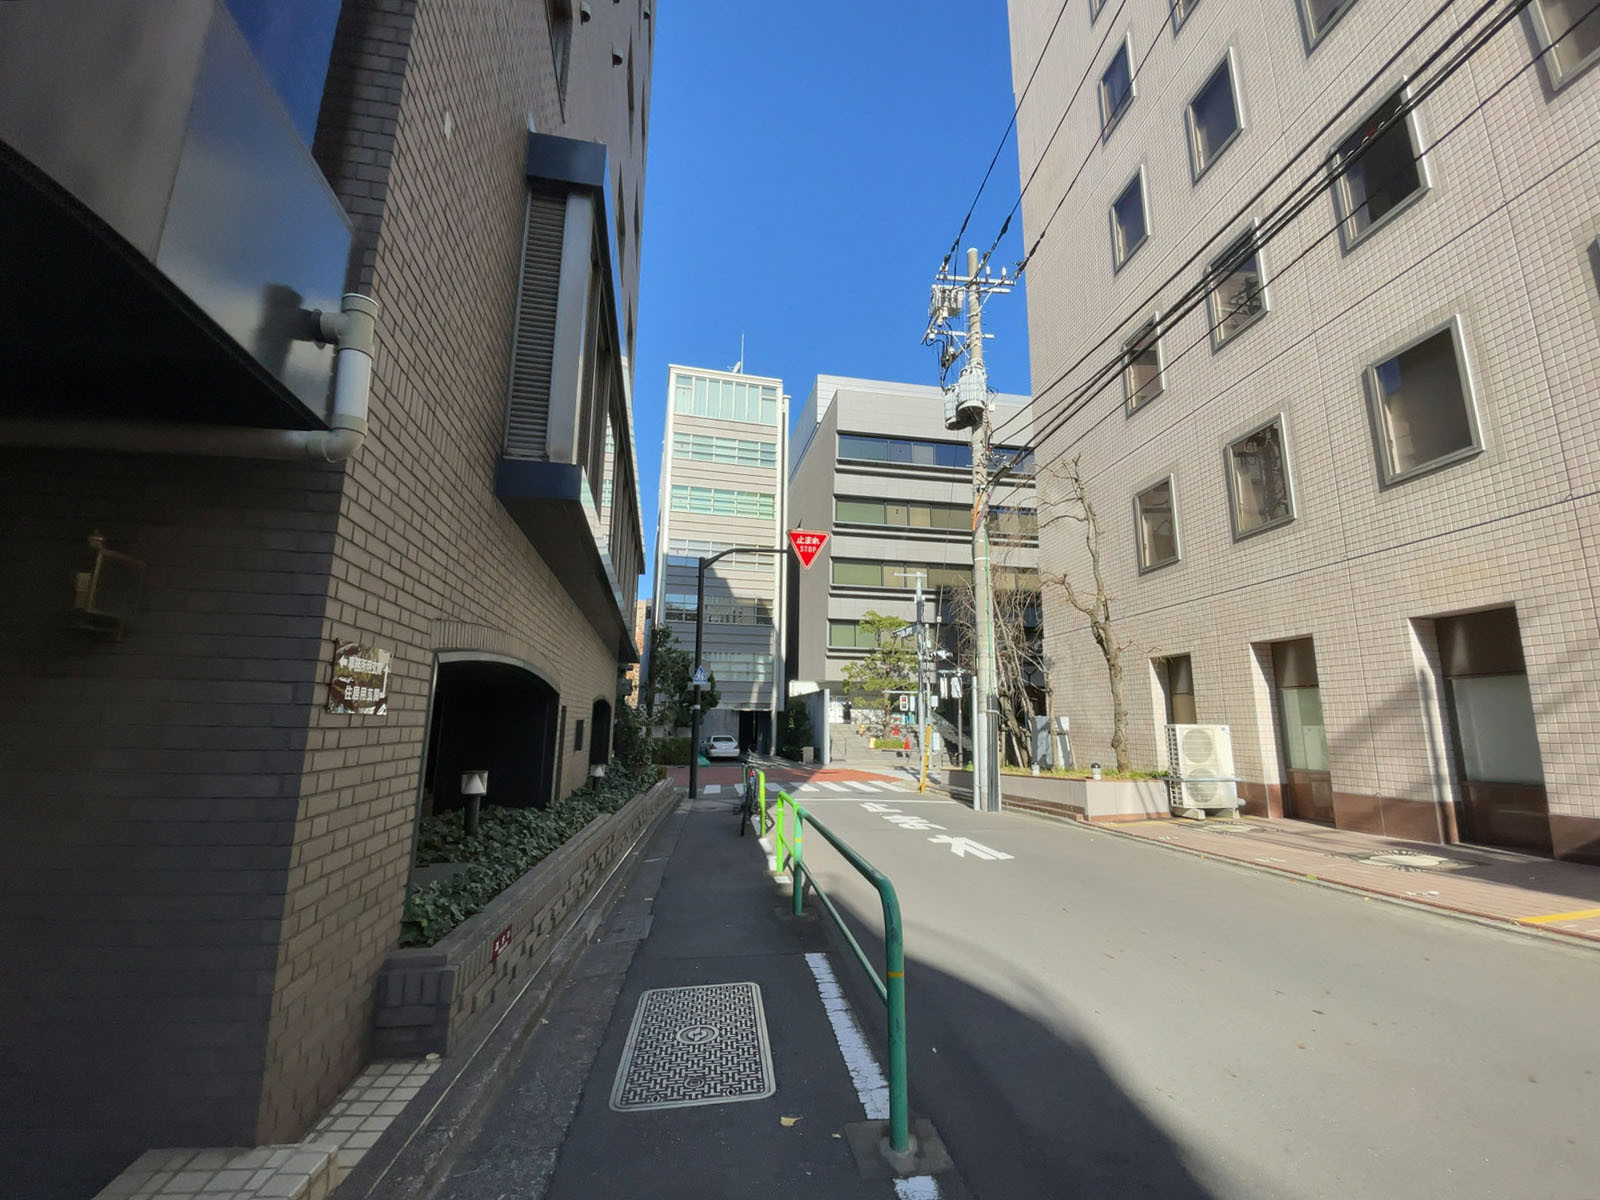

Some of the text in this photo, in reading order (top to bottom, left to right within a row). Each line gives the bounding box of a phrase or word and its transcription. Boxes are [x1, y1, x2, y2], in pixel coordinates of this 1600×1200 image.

[796, 536, 820, 544] 止まれ
[859, 802, 1015, 860] 止まれ
